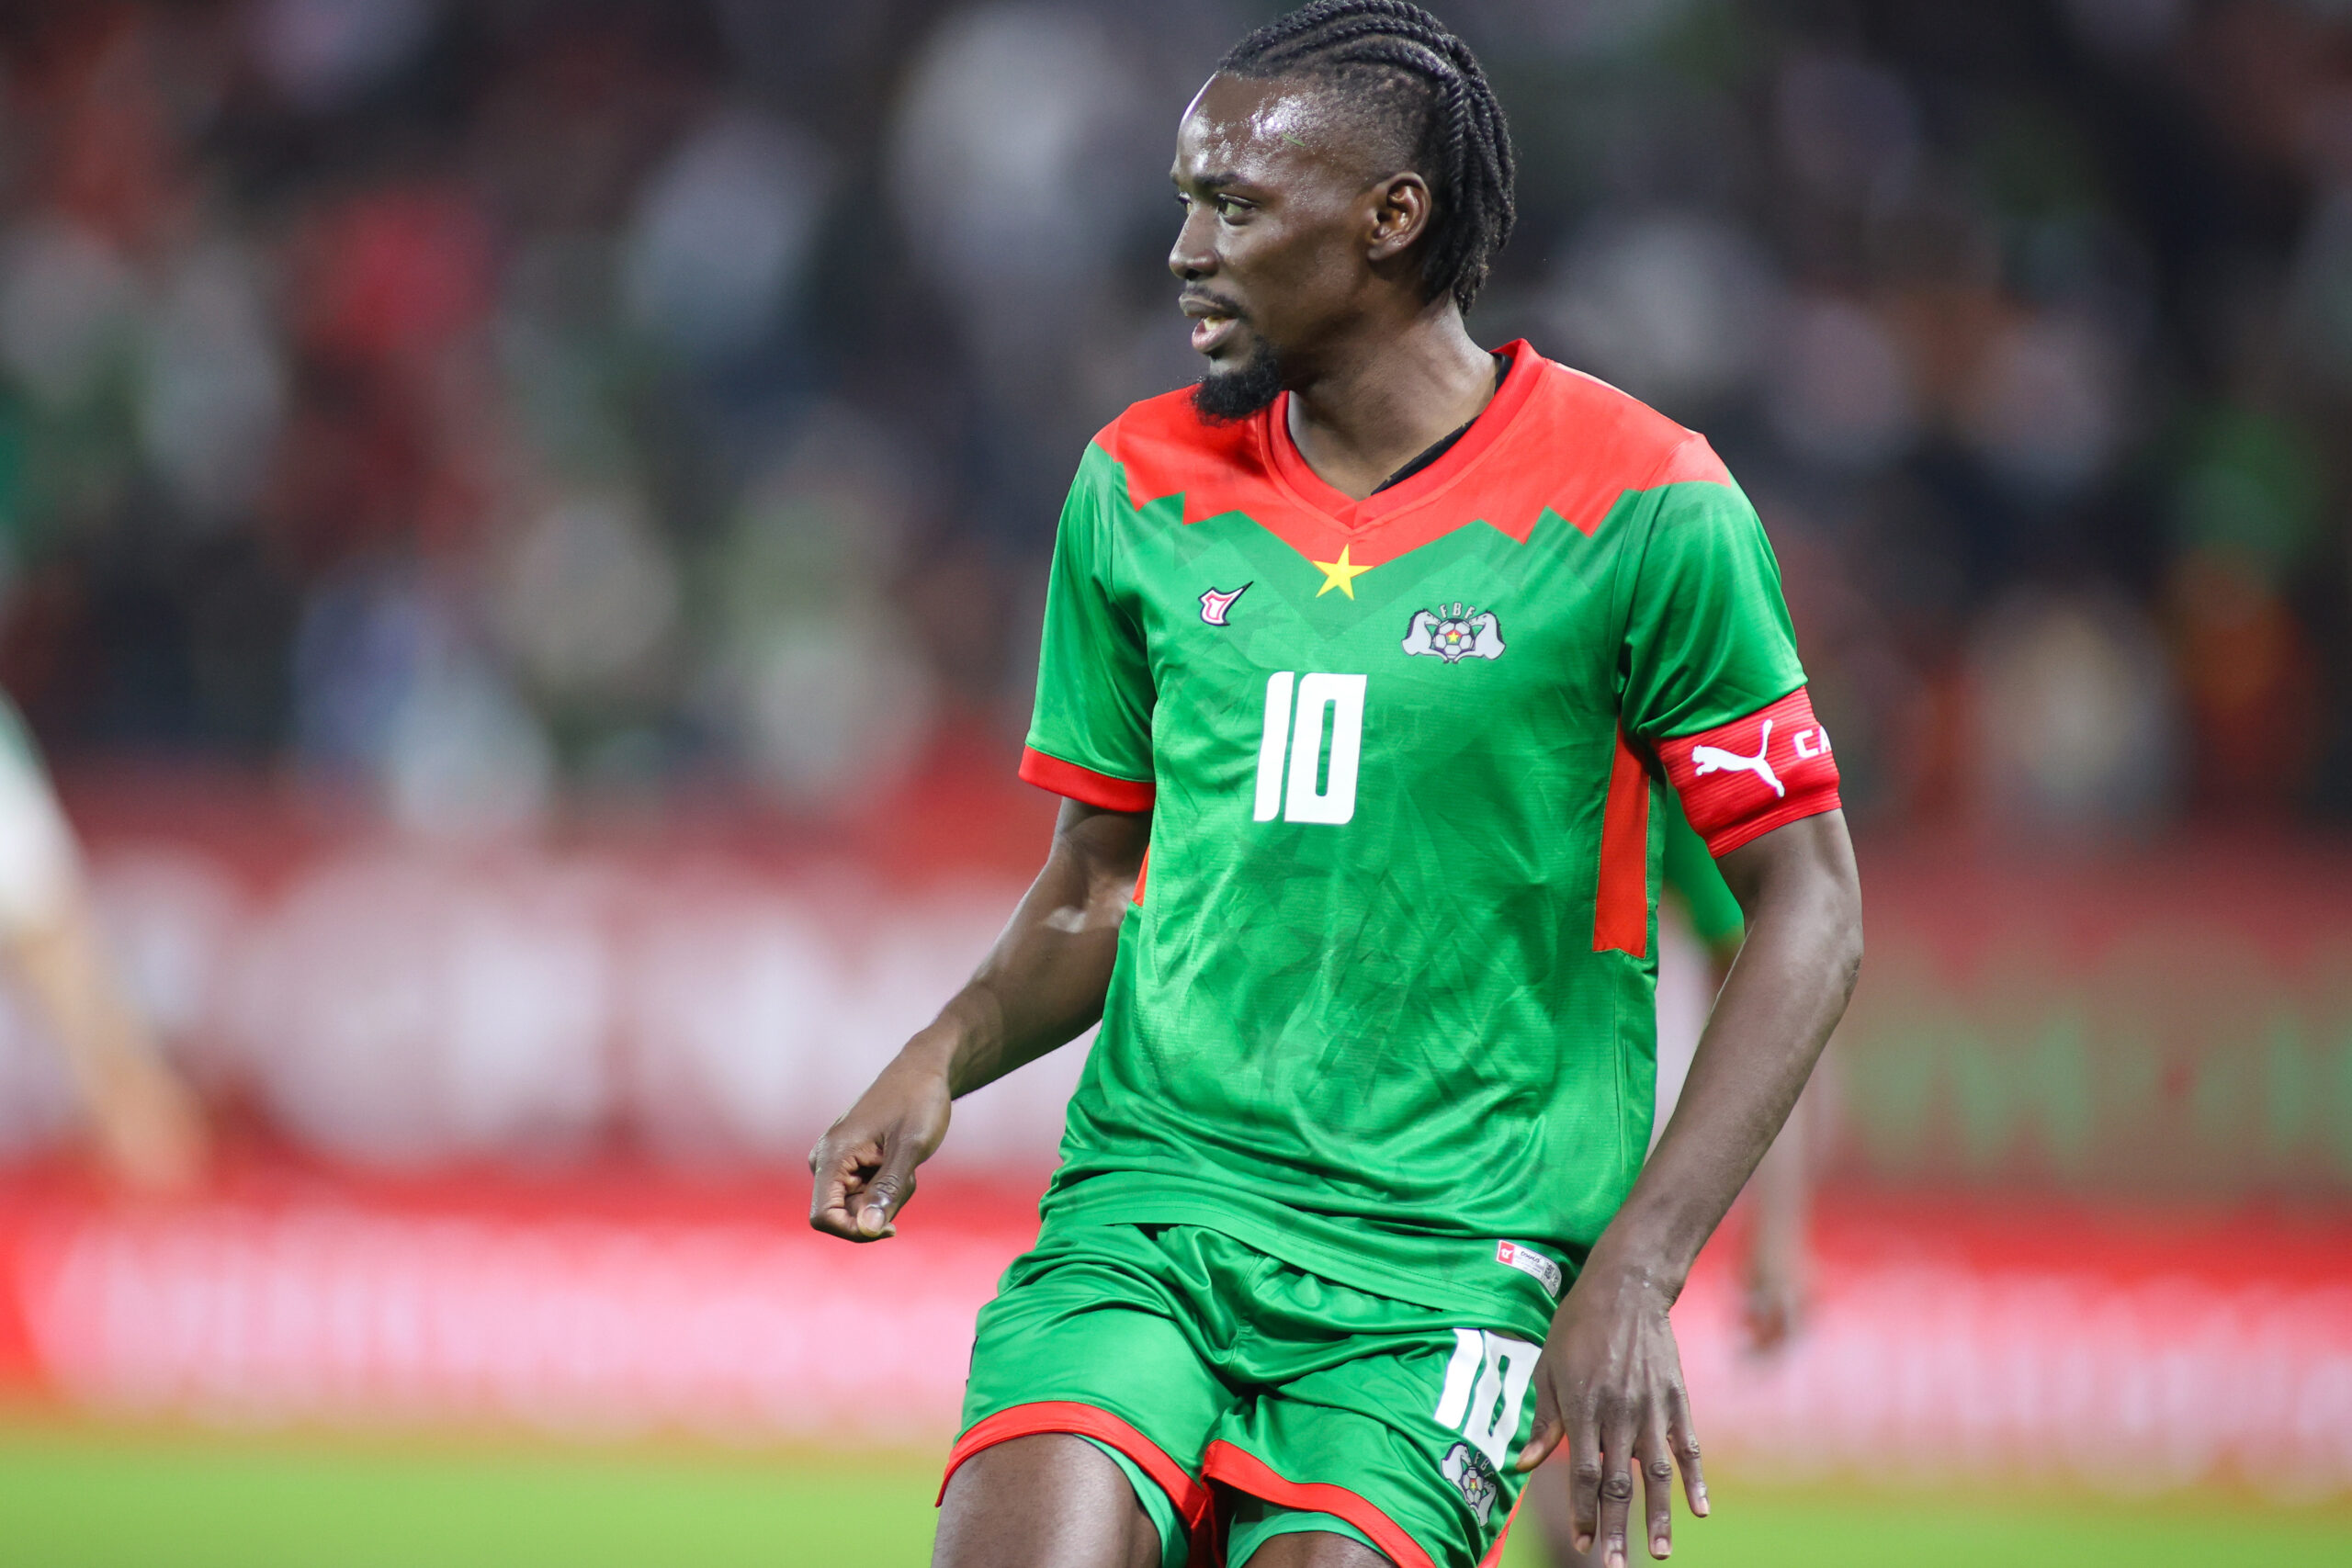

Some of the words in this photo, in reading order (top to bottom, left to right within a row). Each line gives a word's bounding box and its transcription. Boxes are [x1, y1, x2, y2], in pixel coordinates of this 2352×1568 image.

[1439, 602, 1476, 619] FBF
[1253, 671, 1368, 825] 10
[1434, 1328, 1543, 1472] 10
